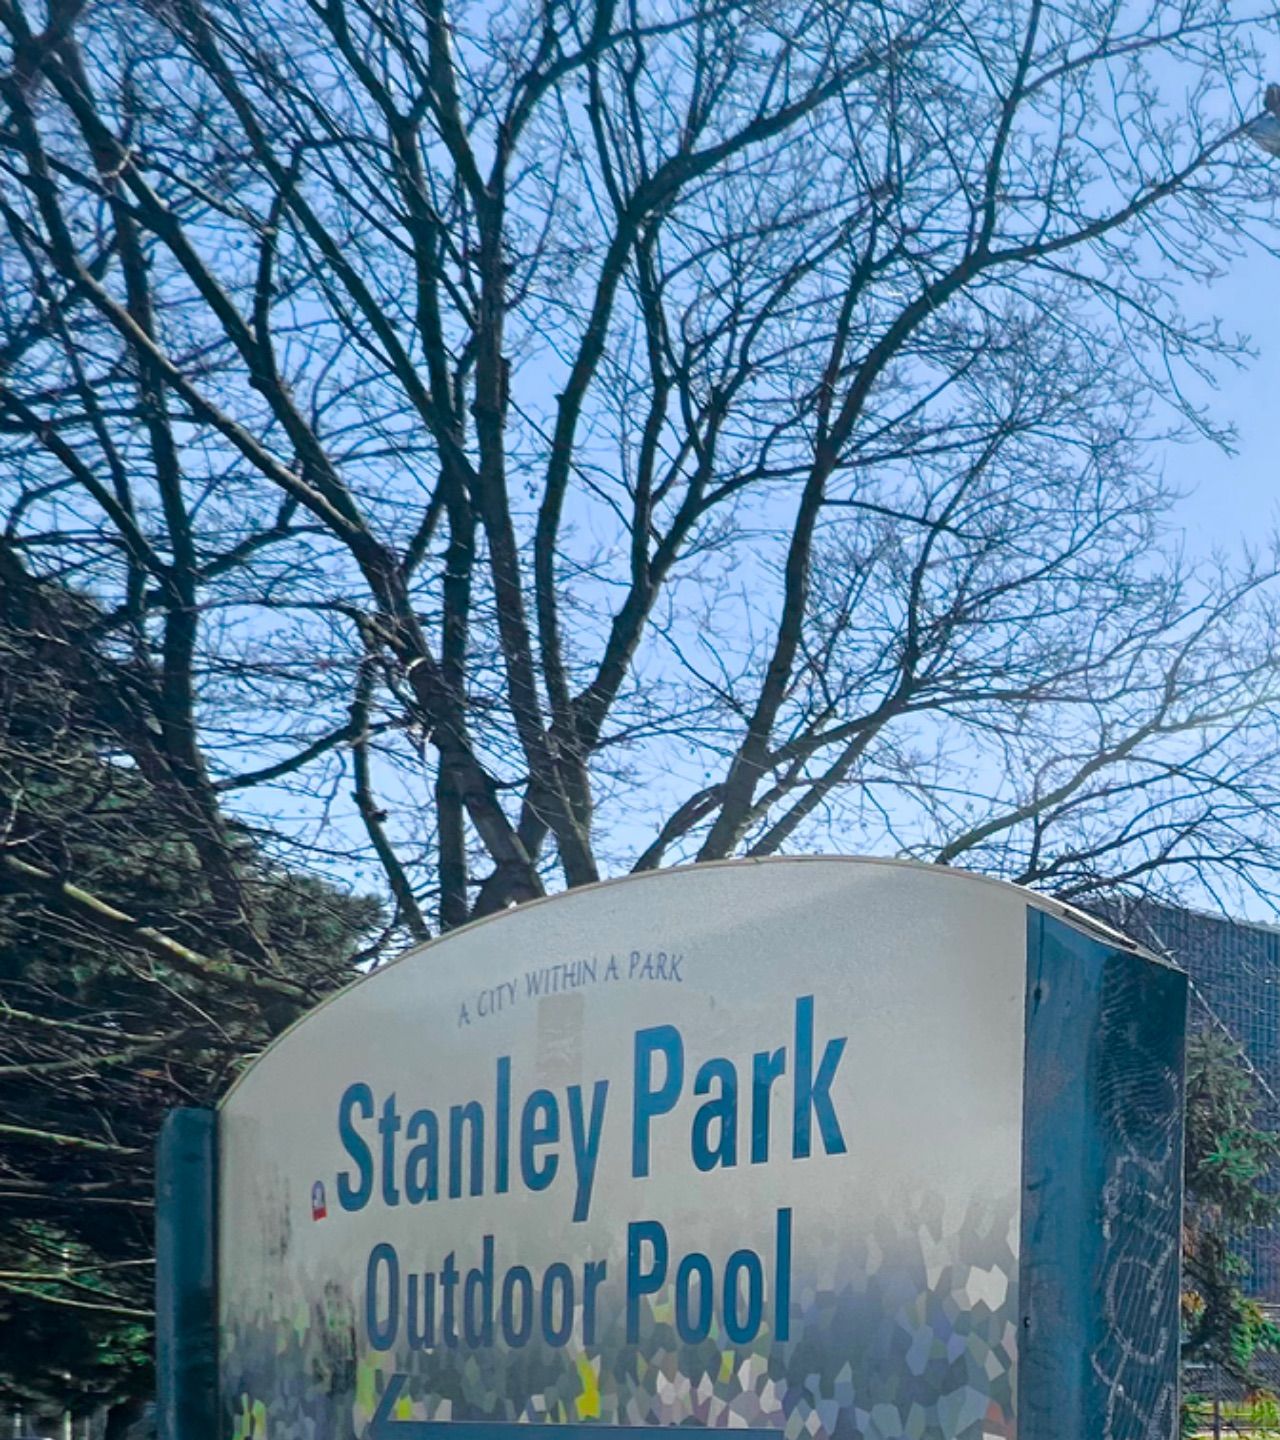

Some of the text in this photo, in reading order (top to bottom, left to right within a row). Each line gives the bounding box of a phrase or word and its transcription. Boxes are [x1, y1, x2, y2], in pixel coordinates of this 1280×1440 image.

[458, 950, 684, 1028] A CITY WITHIN A PARK
[336, 994, 848, 1223] Stanley Park
[366, 1206, 792, 1352] Outdoor Pool
